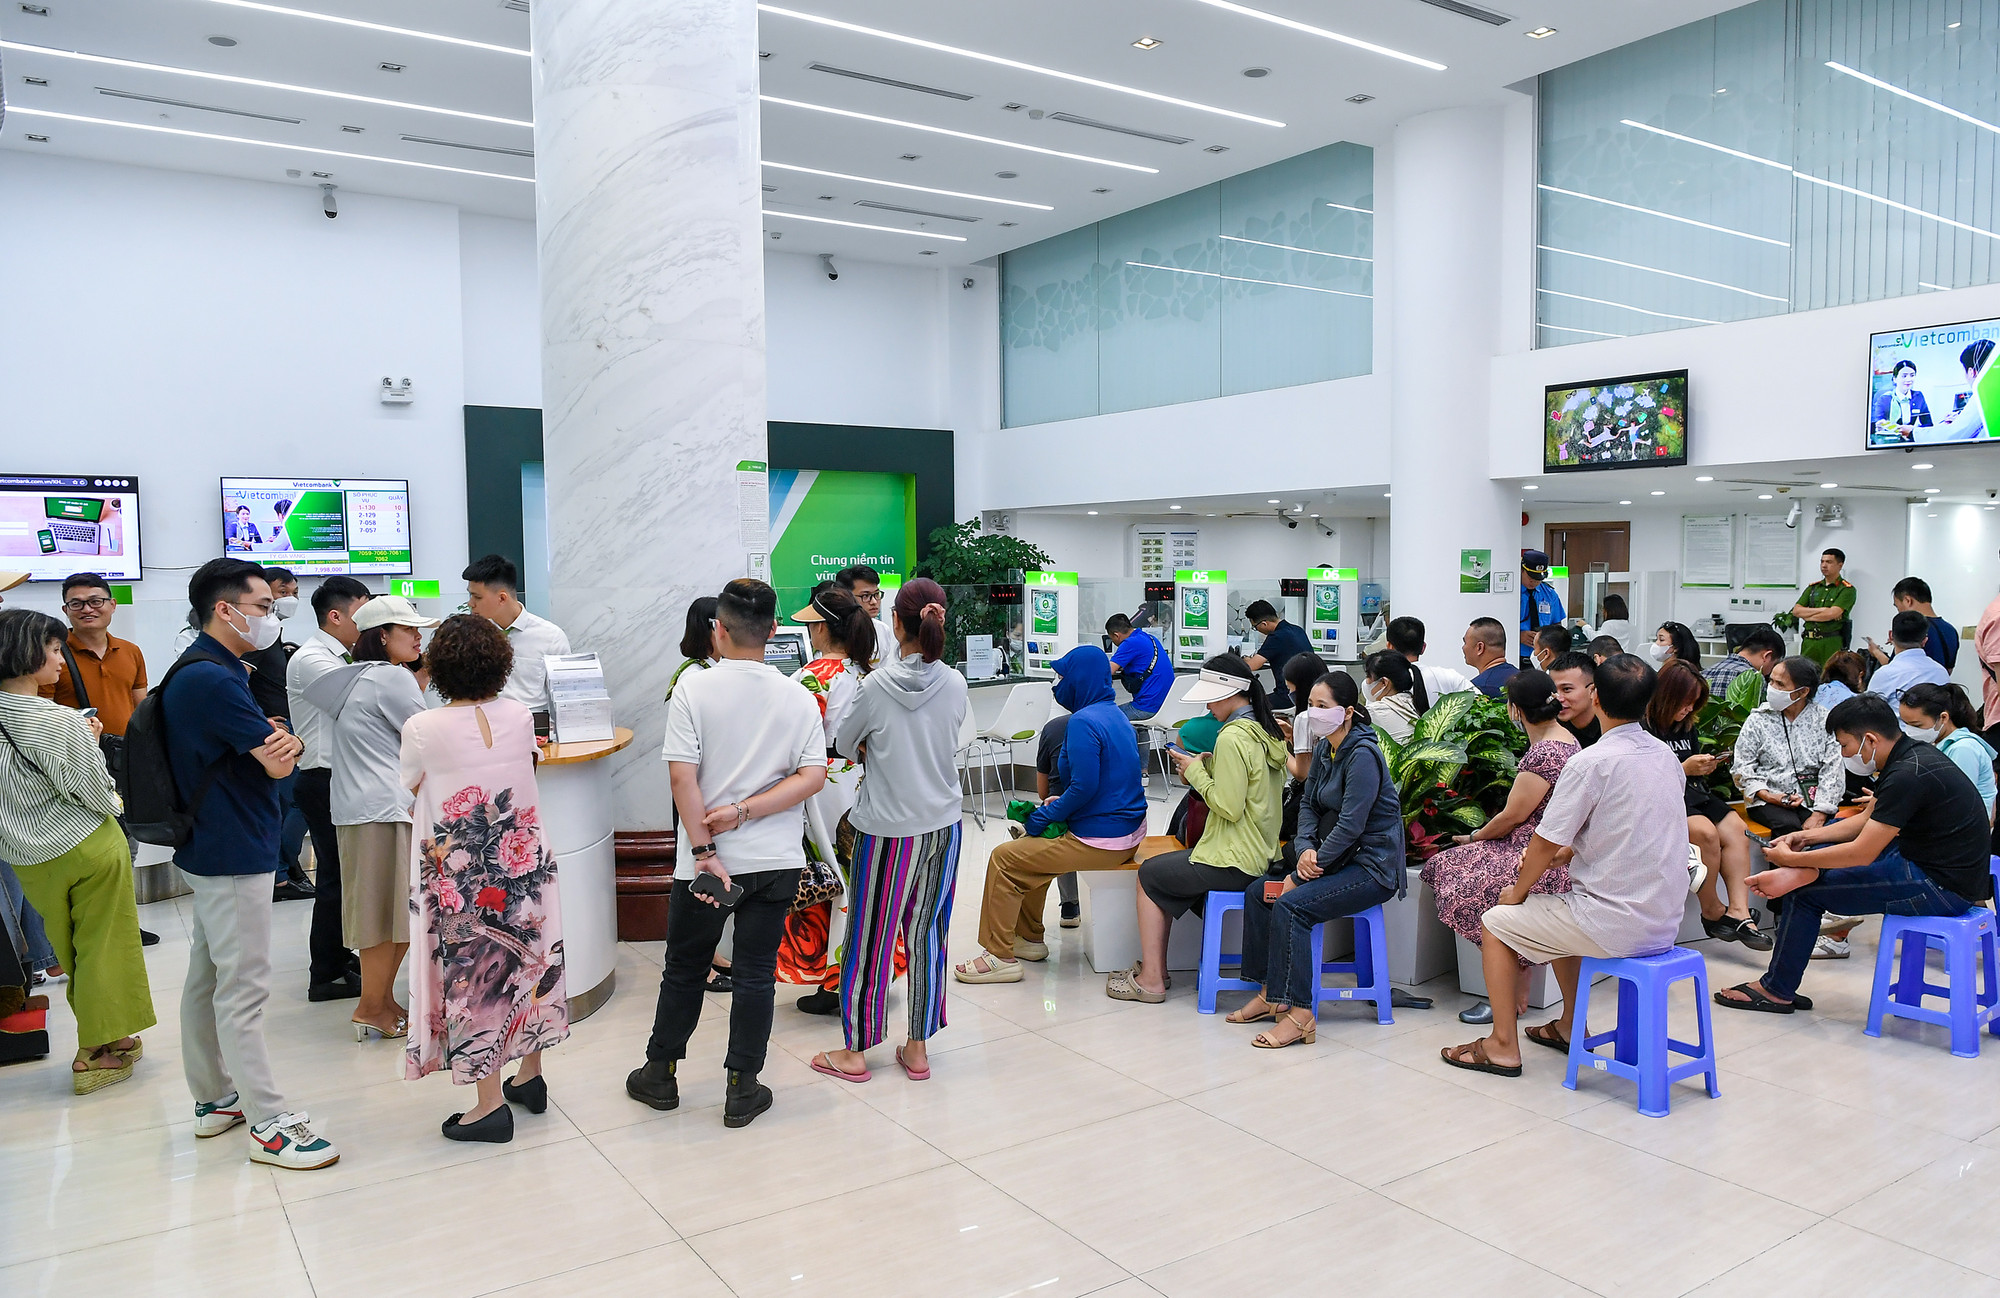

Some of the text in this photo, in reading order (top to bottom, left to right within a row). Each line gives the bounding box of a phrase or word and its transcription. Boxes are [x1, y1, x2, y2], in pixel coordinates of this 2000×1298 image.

[811, 552, 894, 567] Chung niềm tin
[1040, 573, 1058, 585] 04
[1192, 571, 1209, 583] 05
[1322, 569, 1340, 580] 06
[401, 581, 414, 596] 01
